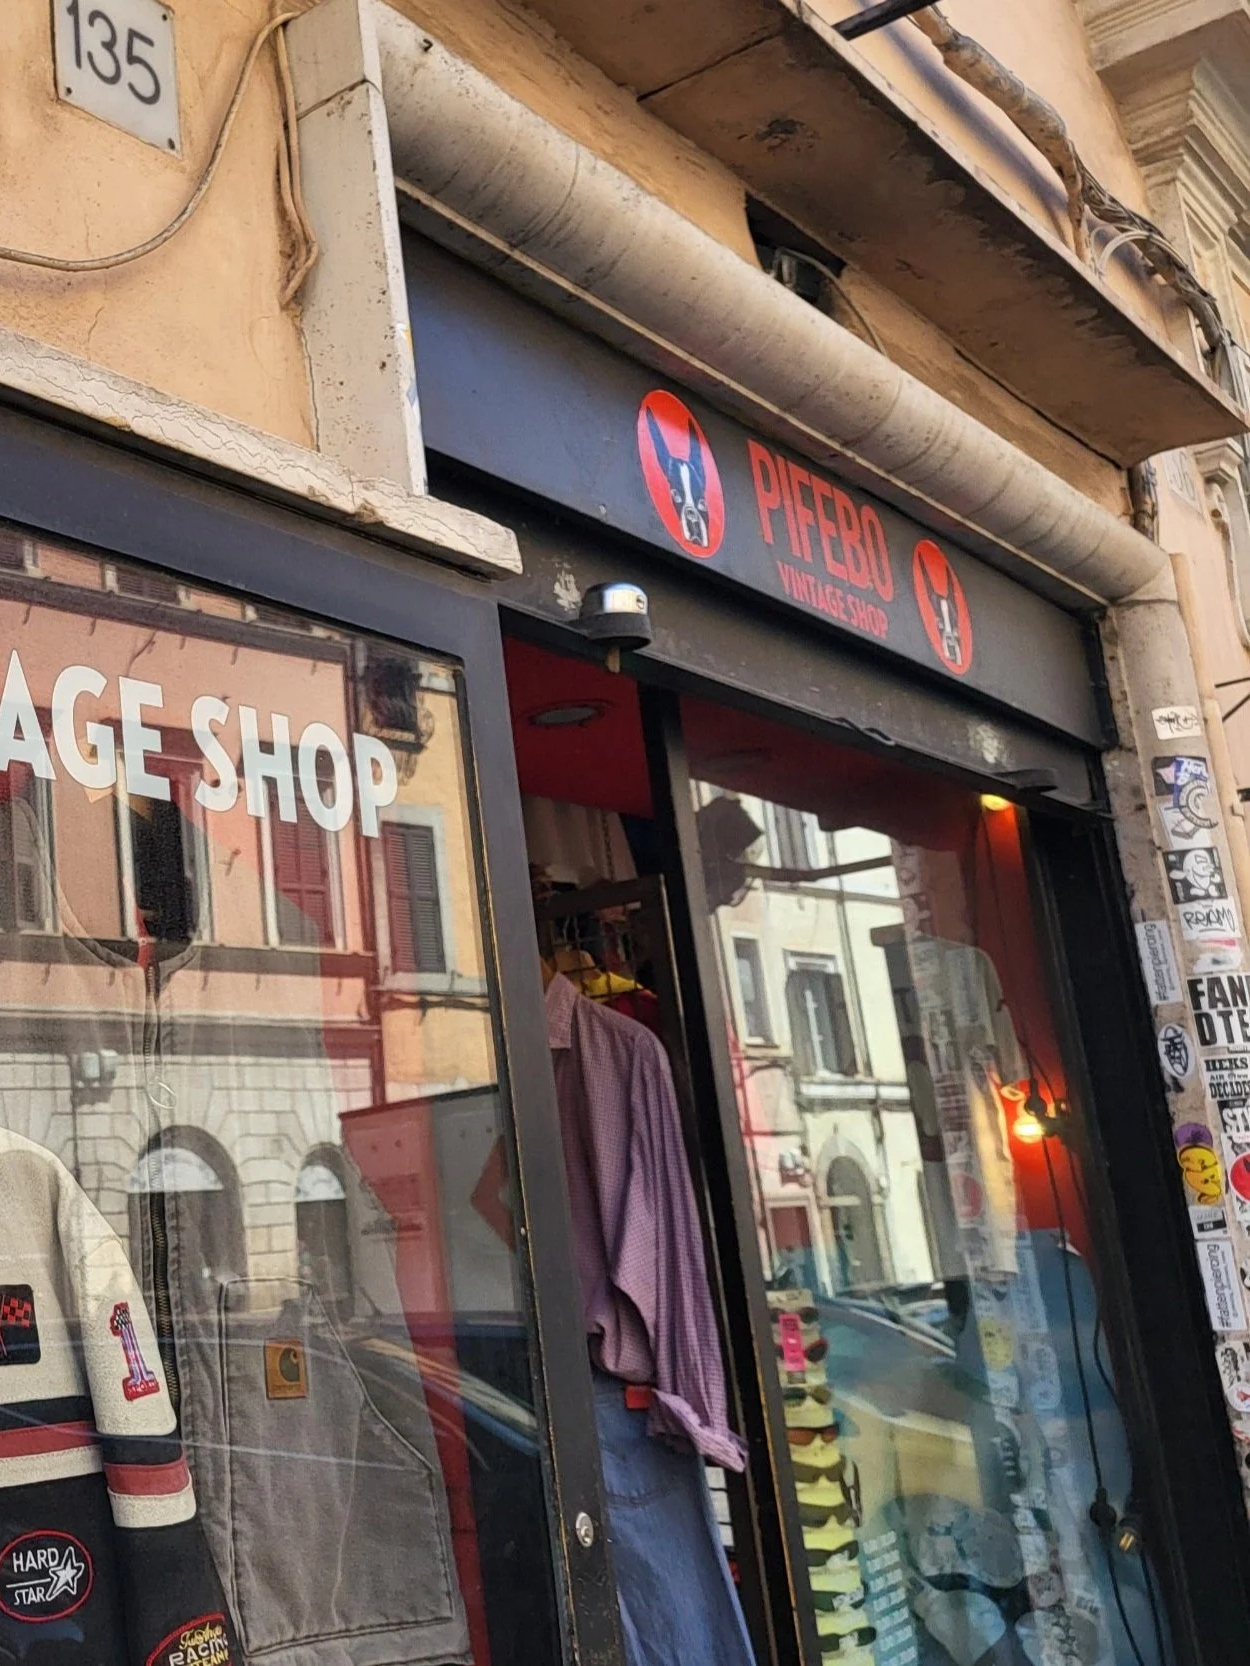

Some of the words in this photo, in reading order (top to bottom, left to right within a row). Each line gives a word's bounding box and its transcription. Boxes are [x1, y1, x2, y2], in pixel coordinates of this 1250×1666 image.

[67, 0, 161, 105] 135
[746, 439, 894, 602] PIFEBO
[777, 560, 848, 621] VINTAGE
[847, 594, 888, 640] SHOP
[190, 694, 398, 838] SHOP
[1187, 975, 1250, 1010] FAN
[12, 1547, 59, 1573] HARD
[13, 1586, 46, 1606] STAR
